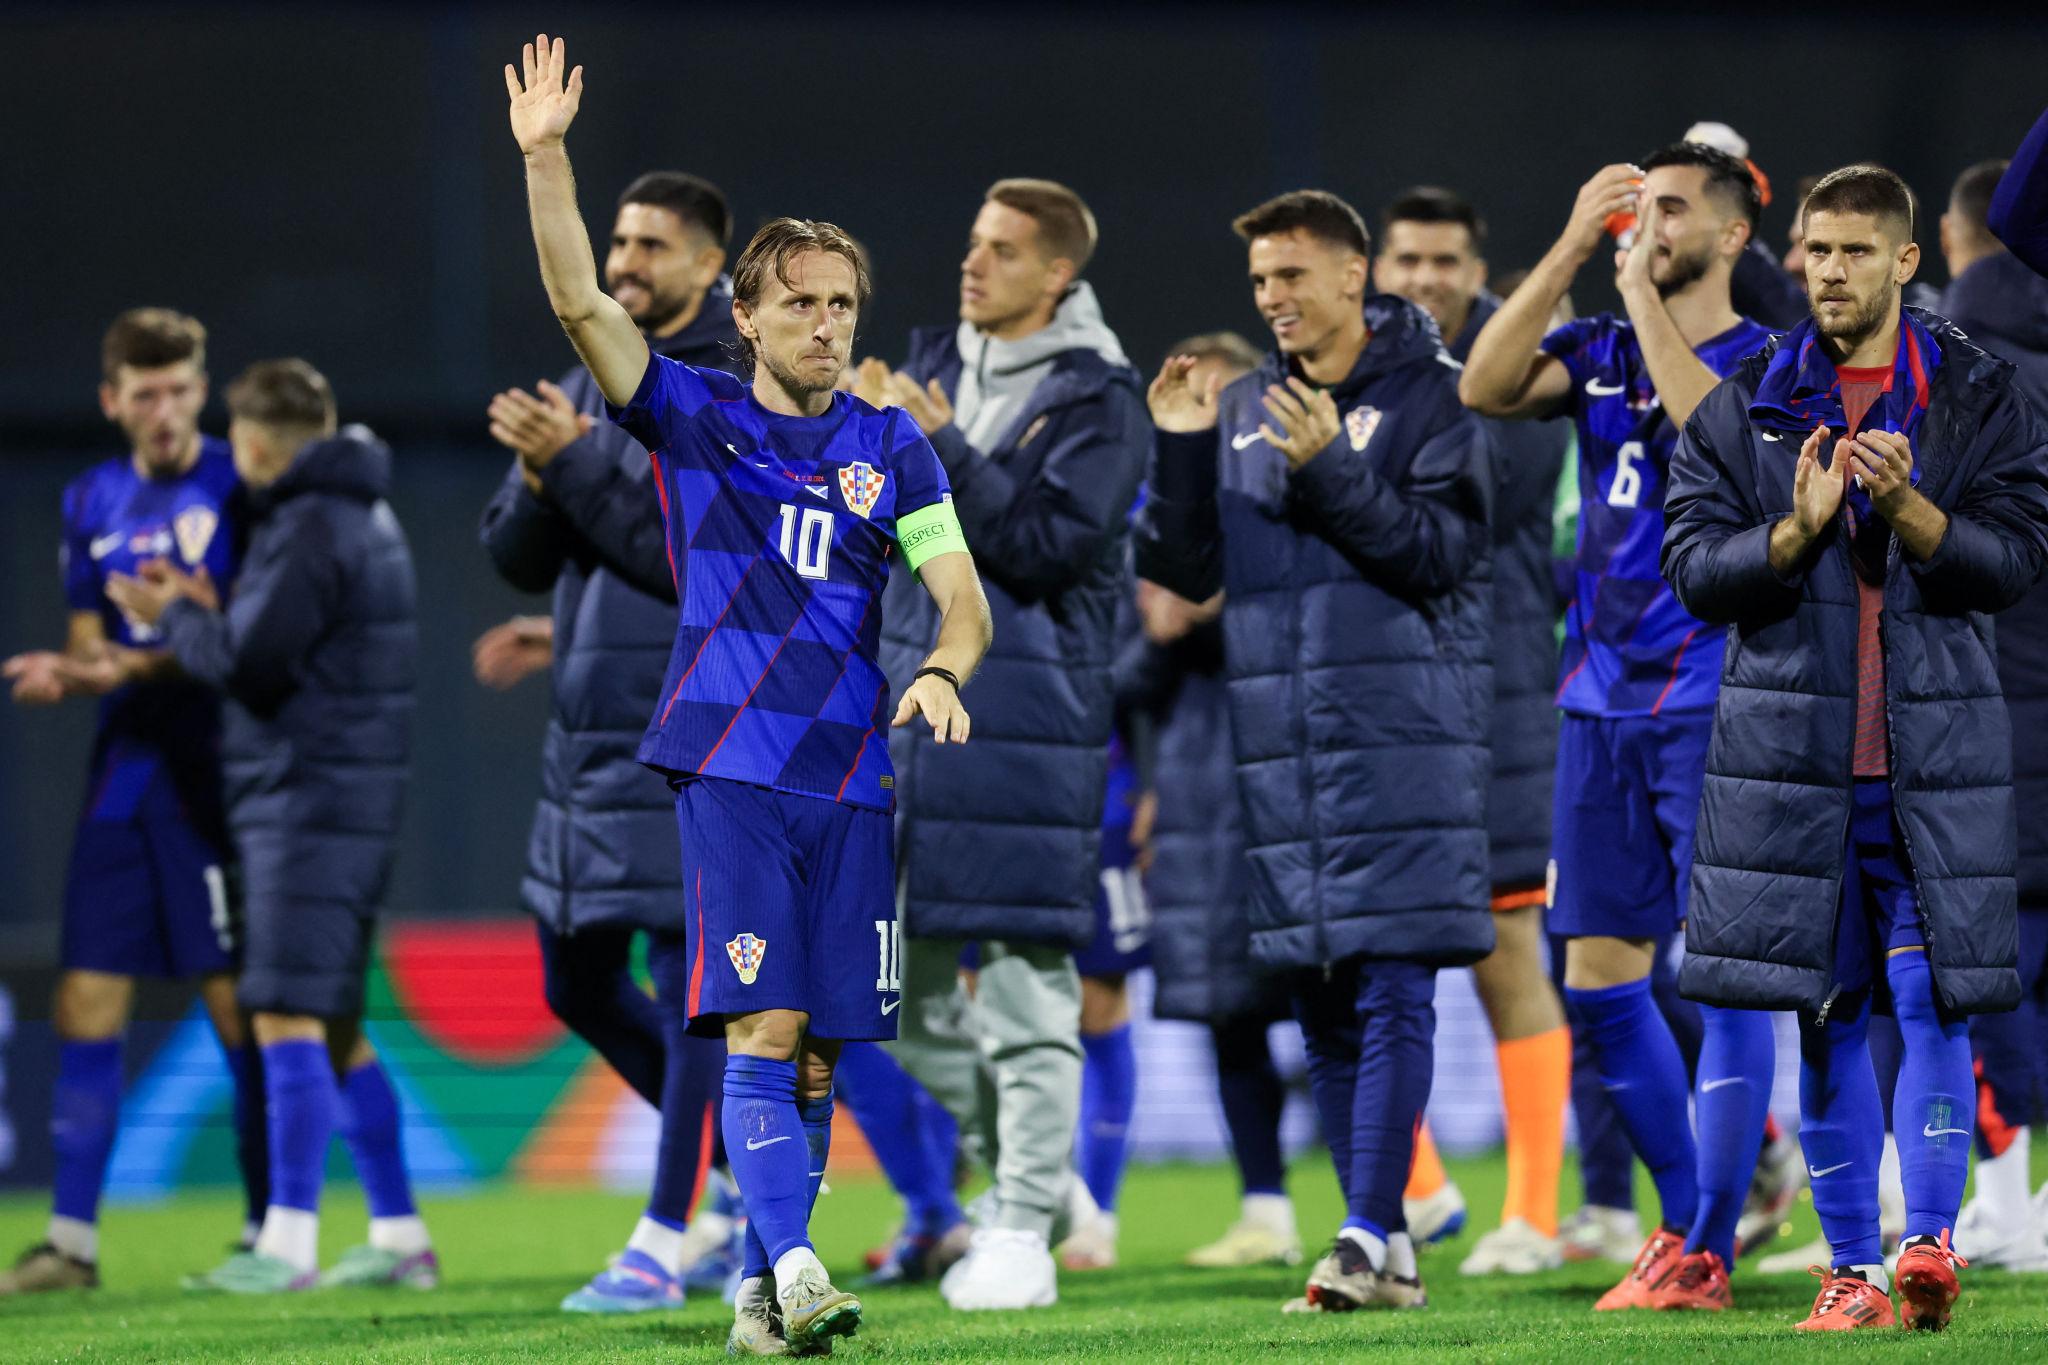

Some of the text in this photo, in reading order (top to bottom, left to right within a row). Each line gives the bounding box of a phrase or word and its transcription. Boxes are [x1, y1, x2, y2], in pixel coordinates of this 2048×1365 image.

[1607, 441, 1645, 508] 6
[780, 503, 834, 581] 10
[902, 523, 945, 550] RESPECT
